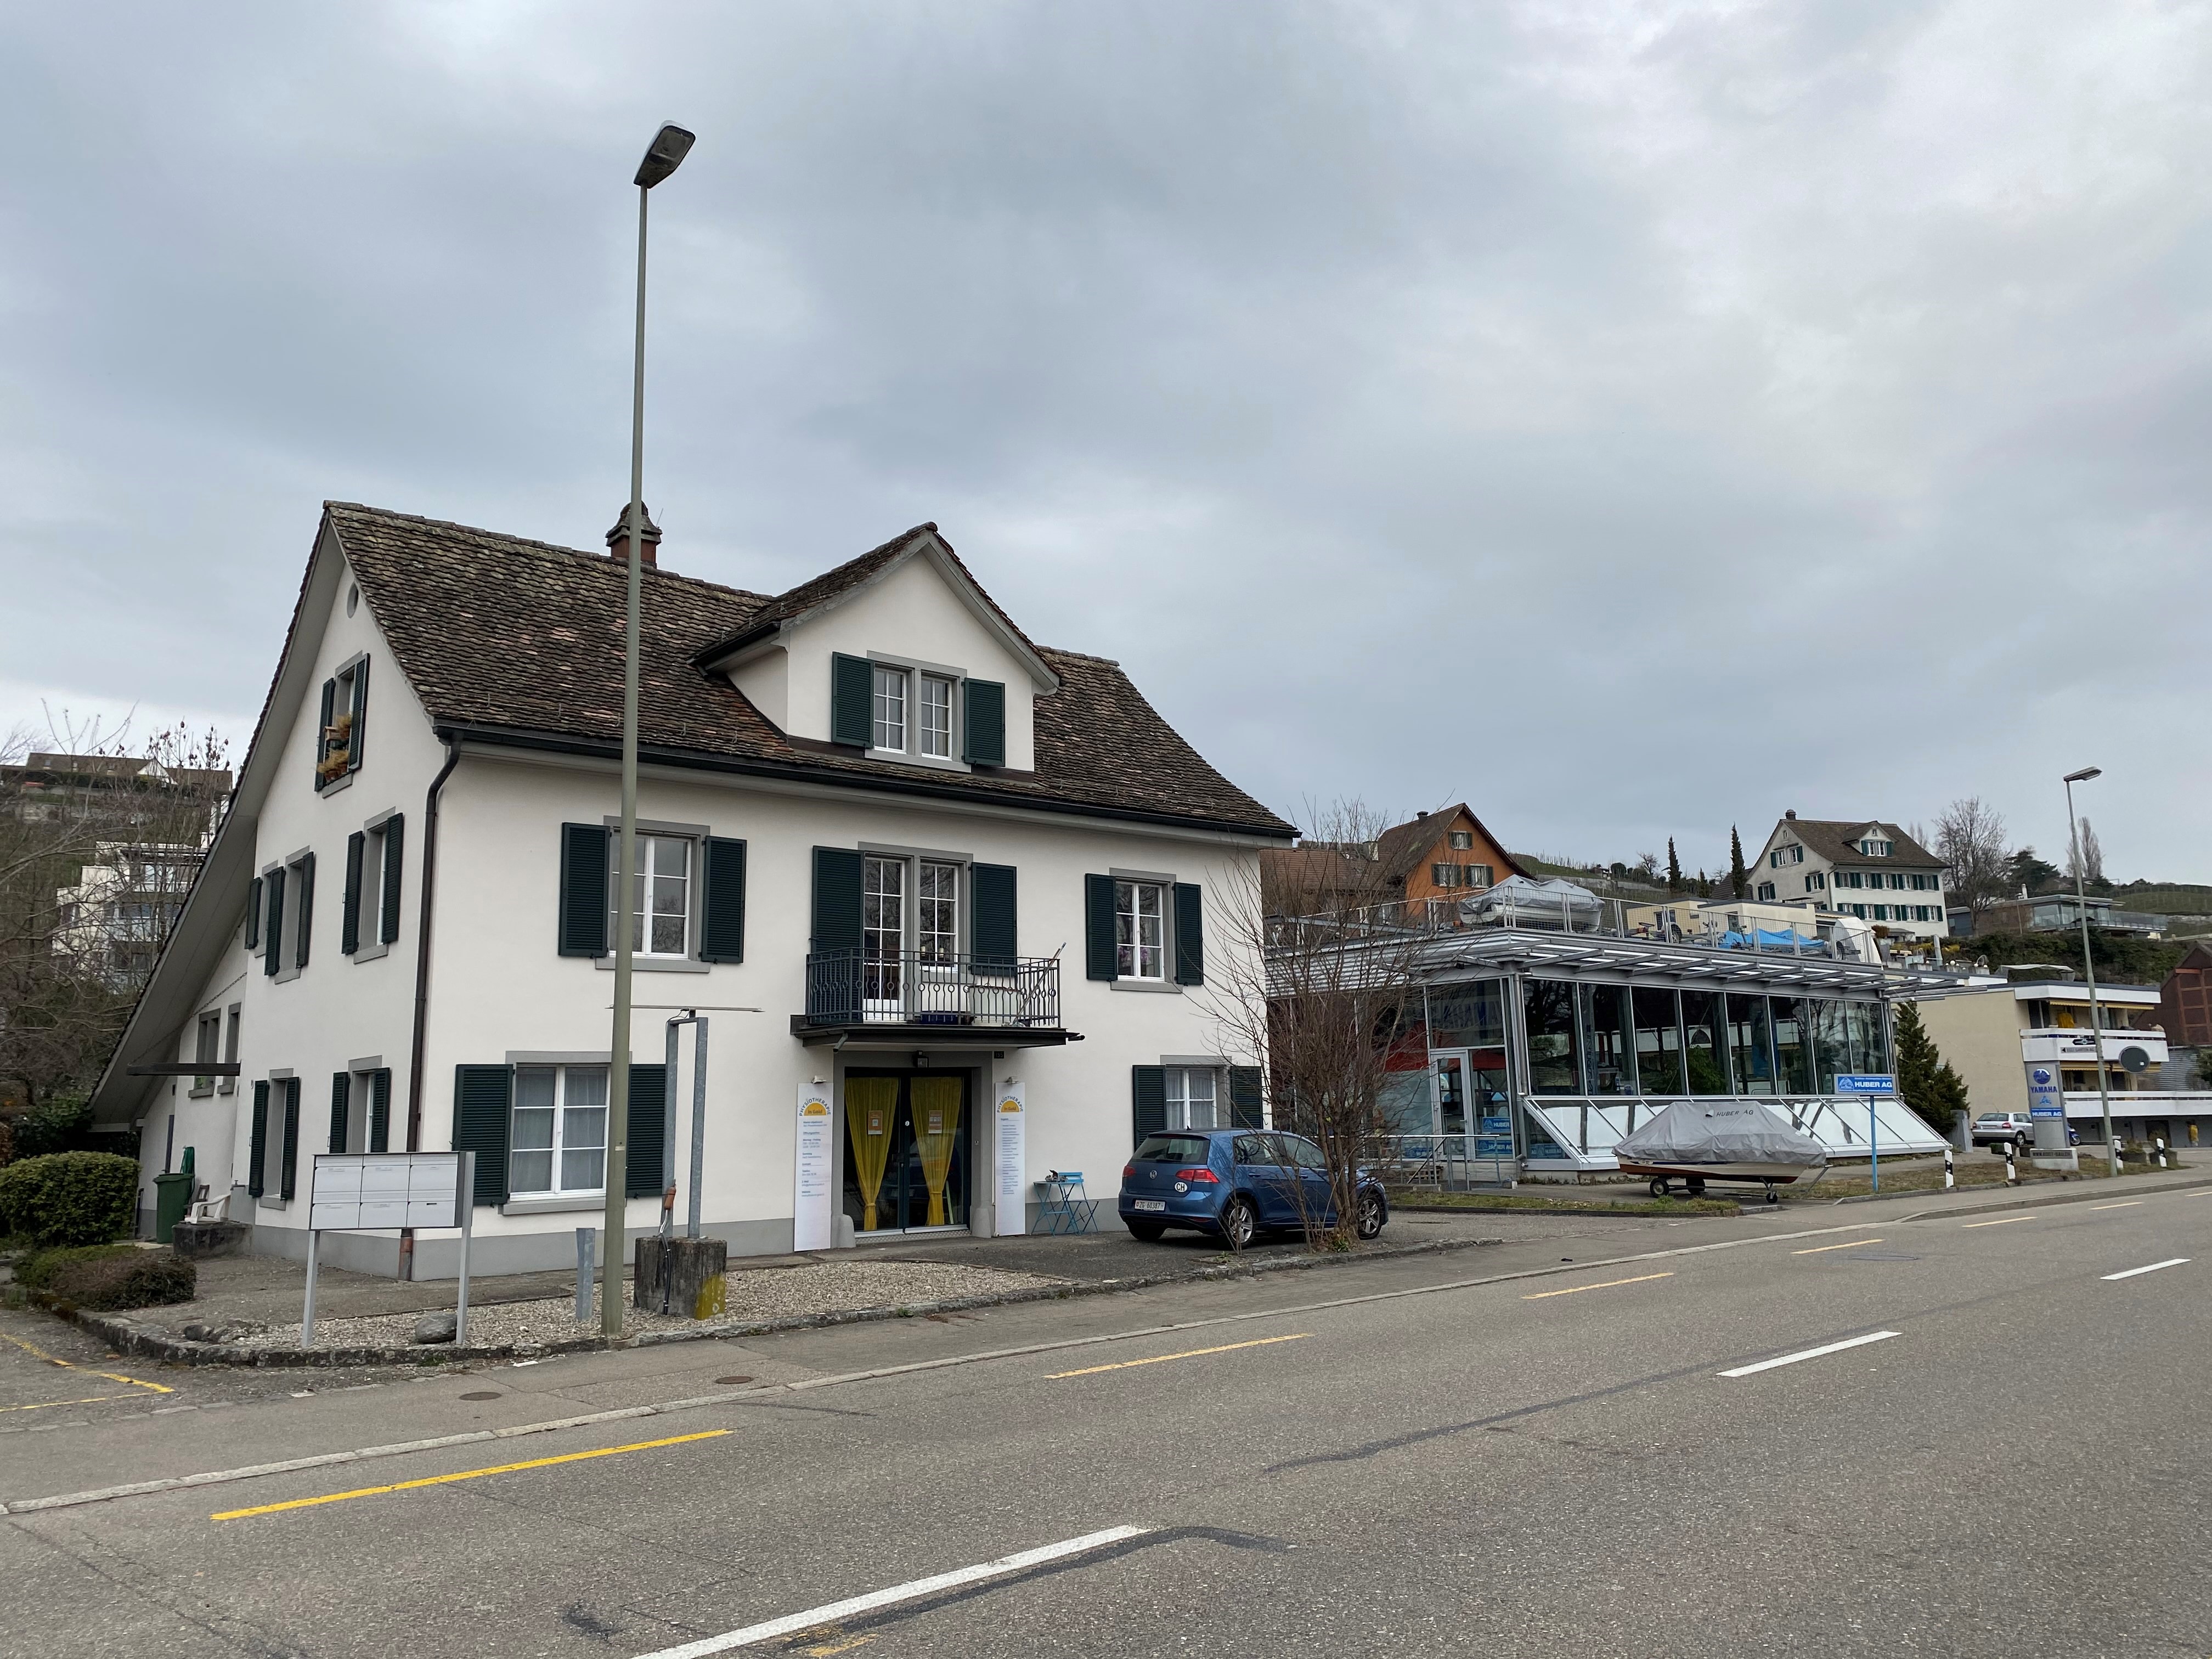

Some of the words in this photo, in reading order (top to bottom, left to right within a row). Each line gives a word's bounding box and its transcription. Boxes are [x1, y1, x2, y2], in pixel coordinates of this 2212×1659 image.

[799, 1097, 831, 1116] PHYSIOTHERAPIE
[997, 1096, 1024, 1113] PHYSIOTHERAPIE
[1176, 1183, 1185, 1191] CH
